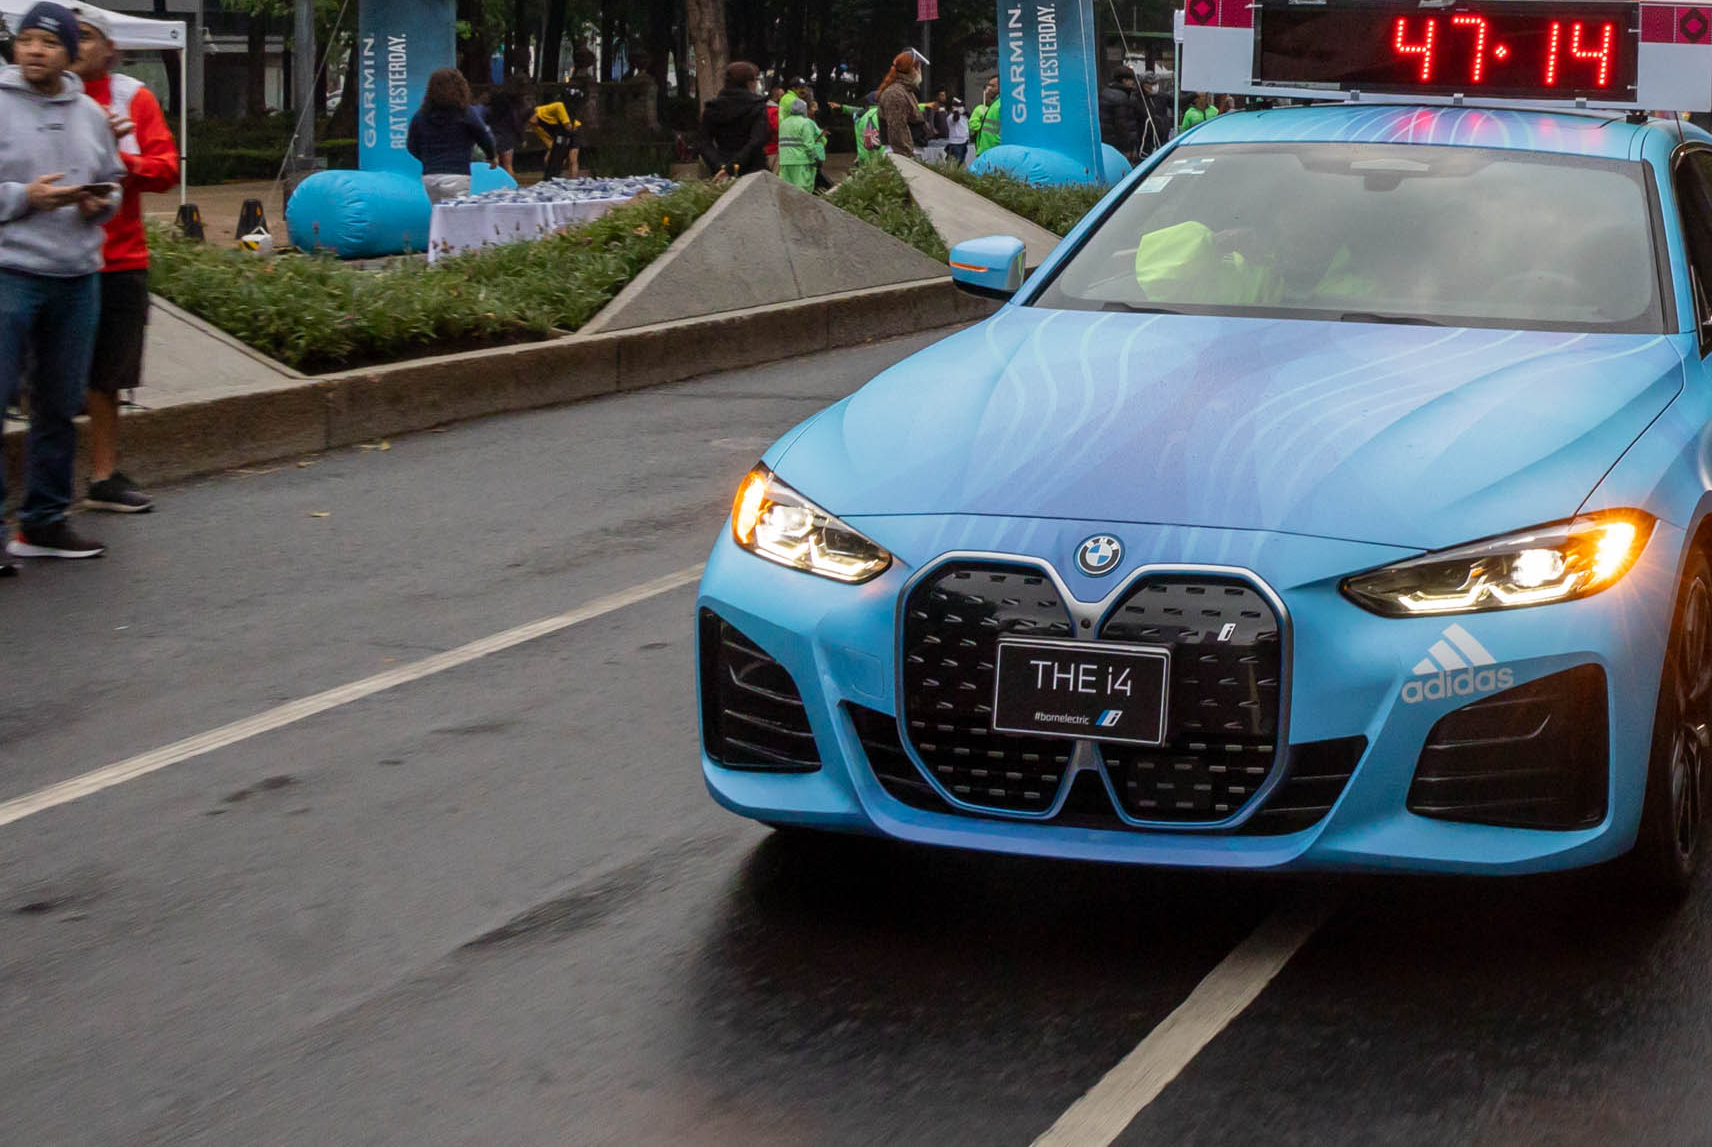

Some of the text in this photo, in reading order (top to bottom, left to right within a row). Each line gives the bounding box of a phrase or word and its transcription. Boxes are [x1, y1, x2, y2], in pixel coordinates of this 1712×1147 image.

[1036, 3, 1062, 124] BEAT YESTERDAY.
[1029, 659, 1132, 697] THE i4
[1401, 666, 1515, 704] adidas
[1034, 711, 1091, 725] #bornelectric
